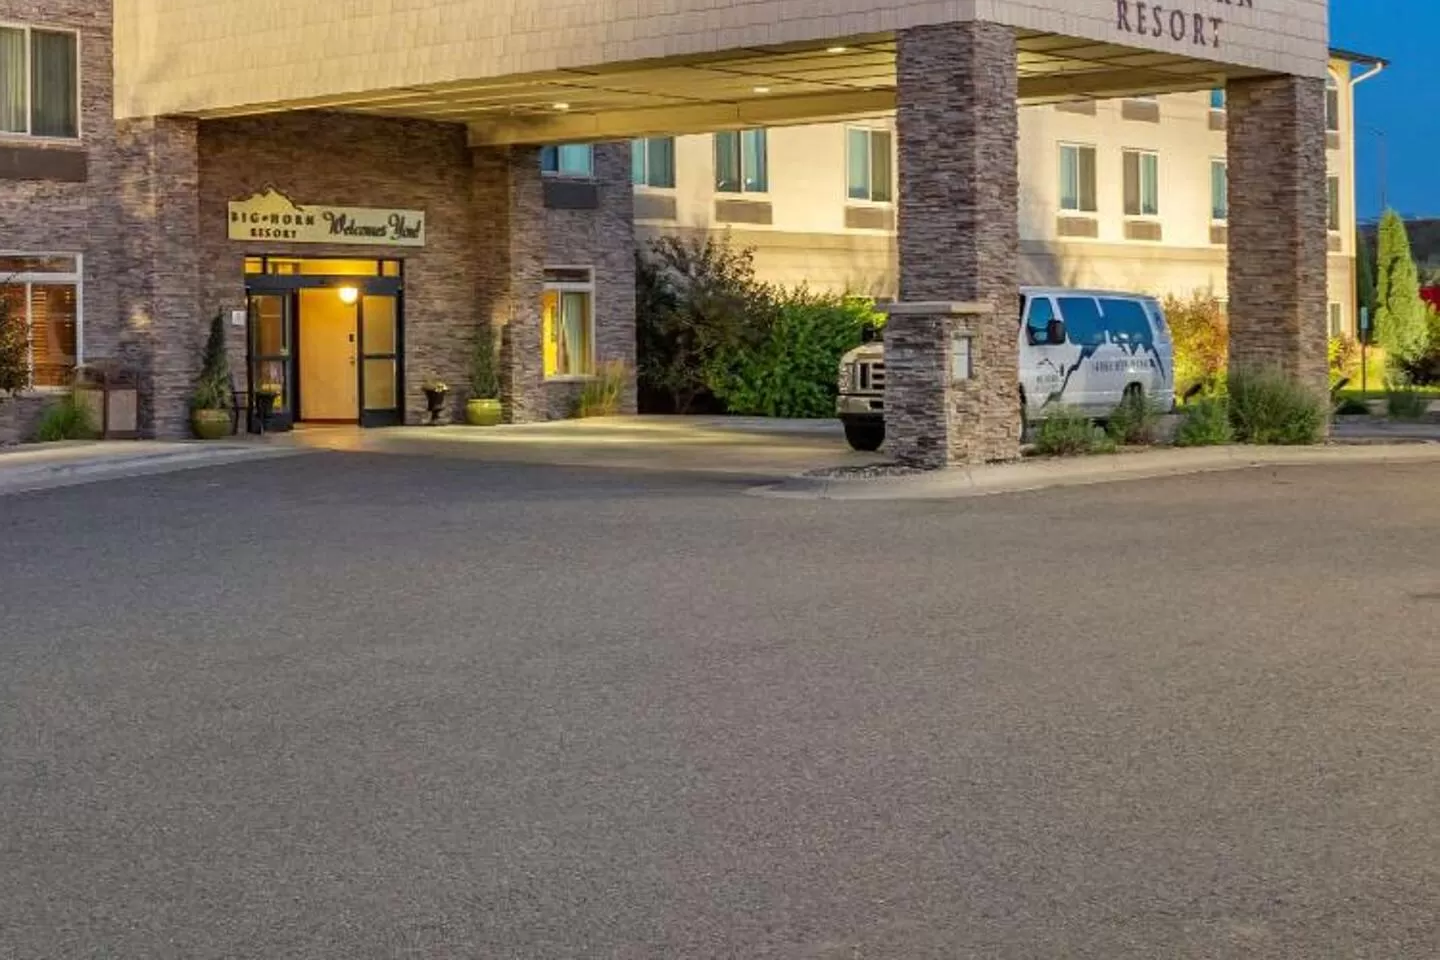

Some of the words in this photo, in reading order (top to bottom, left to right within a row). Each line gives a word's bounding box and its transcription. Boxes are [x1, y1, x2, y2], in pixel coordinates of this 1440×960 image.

[231, 211, 259, 224] BIG
[270, 213, 315, 226] HORN
[250, 228, 297, 239] RESORT
